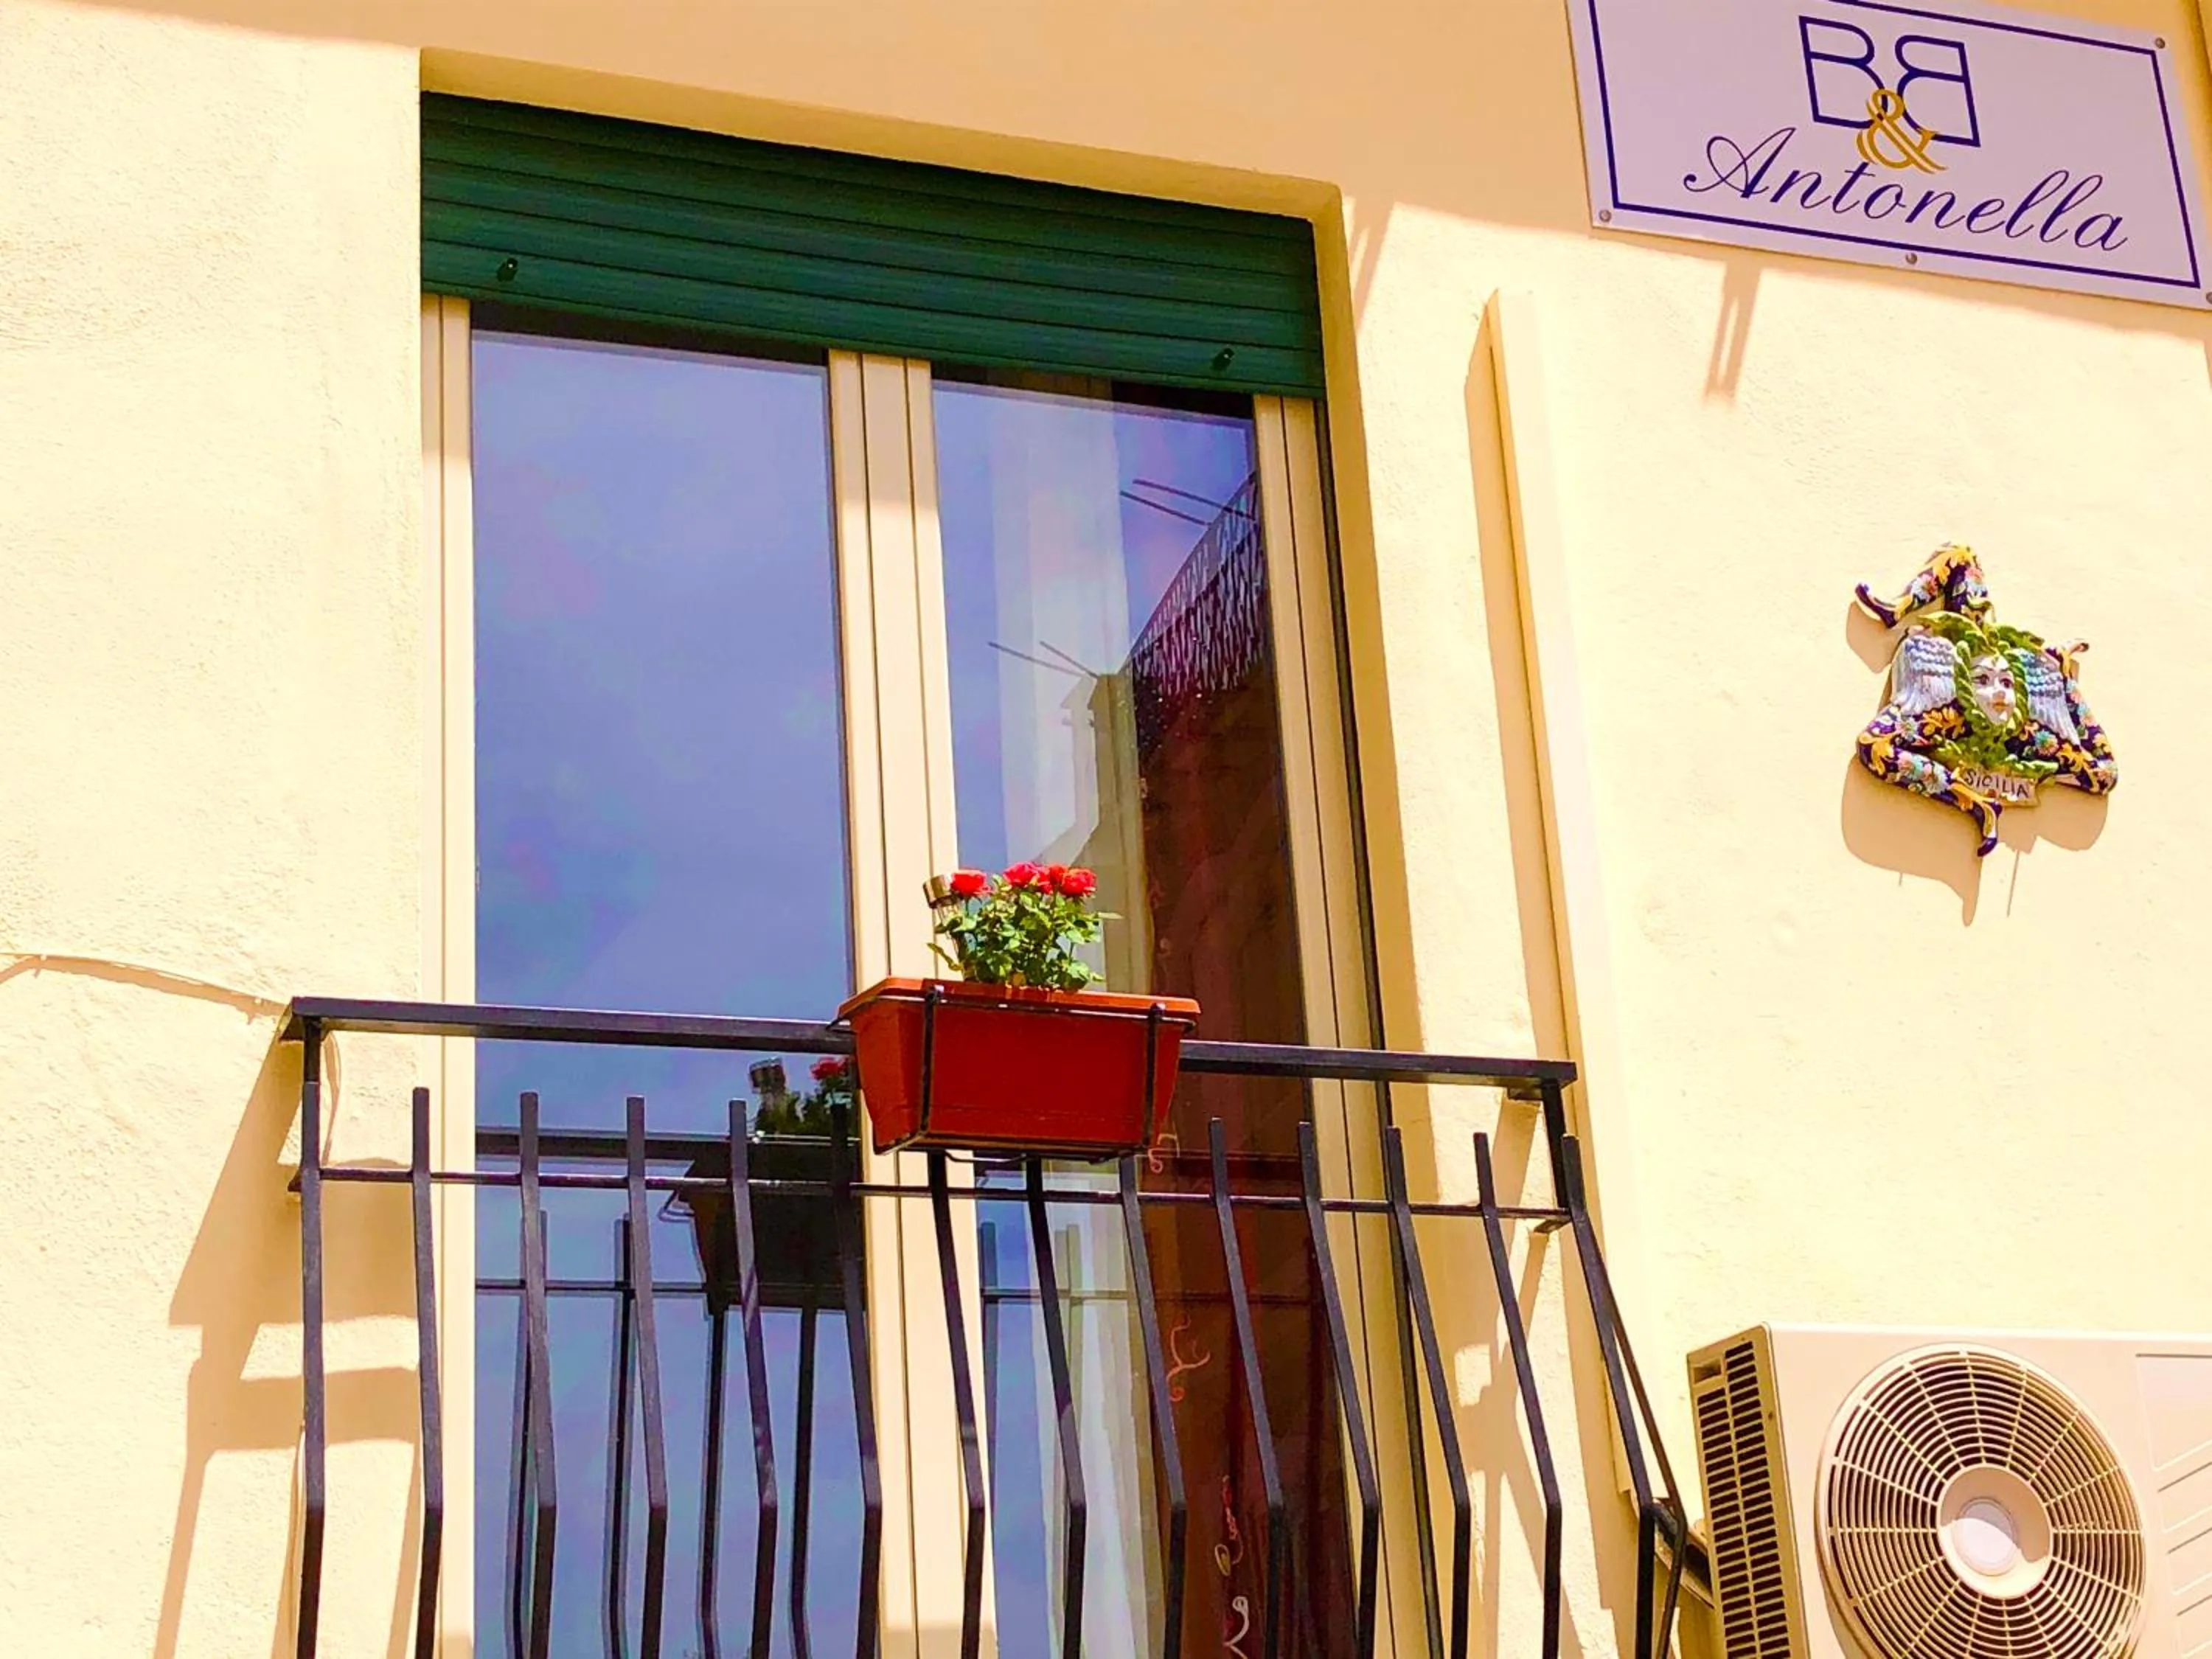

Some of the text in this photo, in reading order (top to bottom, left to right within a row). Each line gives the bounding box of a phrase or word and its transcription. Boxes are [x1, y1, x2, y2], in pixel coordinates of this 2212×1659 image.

[1799, 15, 1980, 173] B&B
[1683, 127, 2128, 251] Antonella
[1964, 768, 2028, 798] SICILIA
